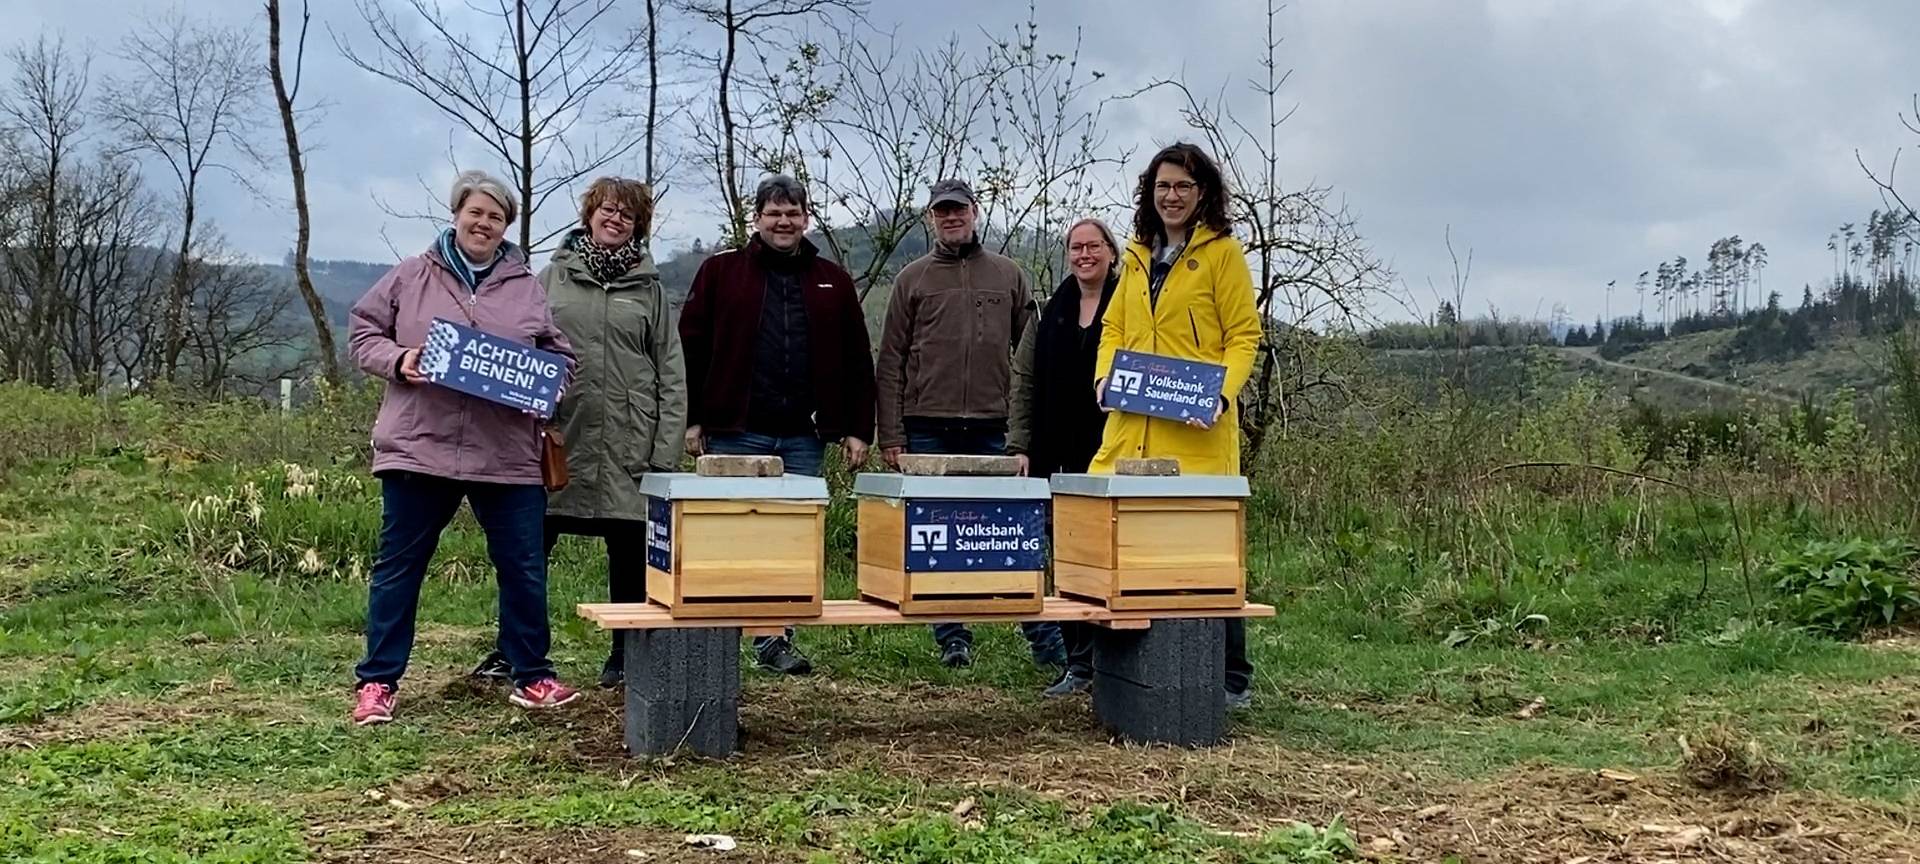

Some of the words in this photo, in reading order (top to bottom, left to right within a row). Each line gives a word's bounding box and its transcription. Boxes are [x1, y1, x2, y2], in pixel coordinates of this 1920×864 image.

[464, 339, 558, 379] ACHTUNG
[460, 355, 535, 390] BIENEN!
[1149, 374, 1204, 394] Volksbank
[1144, 386, 1198, 406] Sauerland
[1198, 397, 1214, 408] eG
[955, 523, 1025, 537] Volksbank
[955, 537, 1019, 551] Sauerland
[1022, 538, 1039, 551] eG
